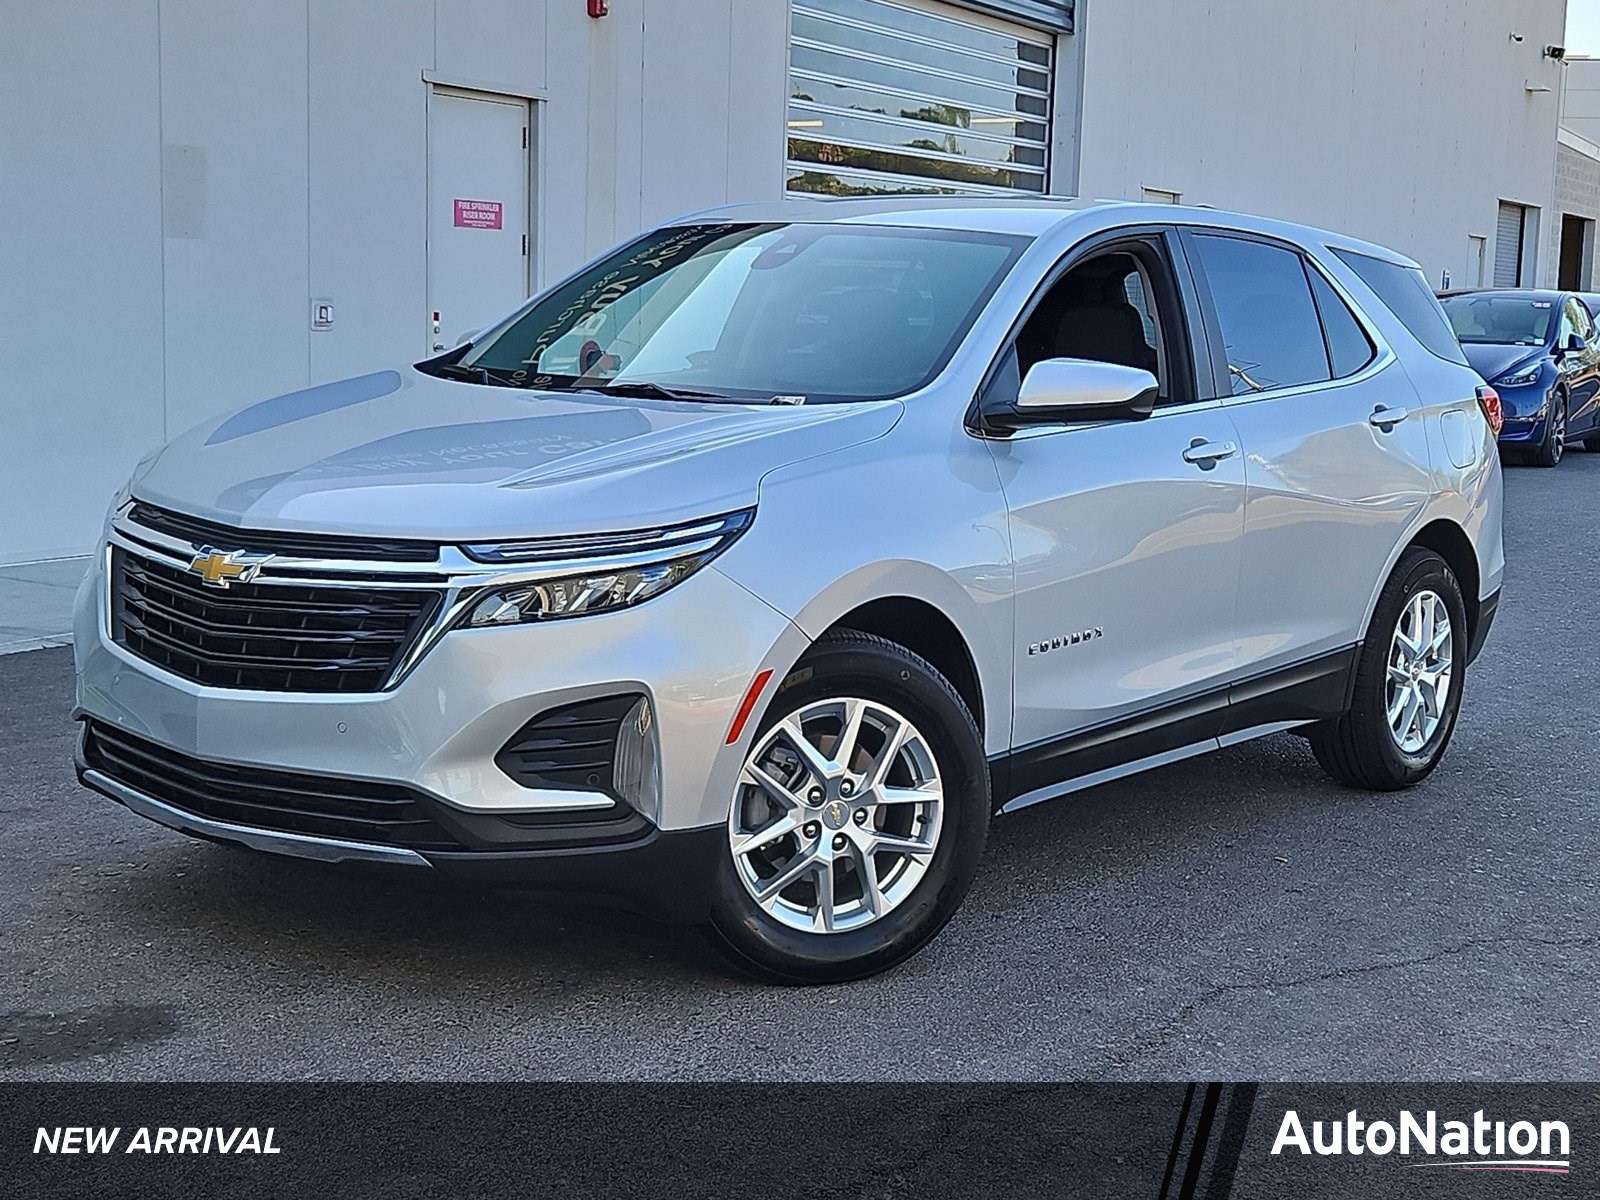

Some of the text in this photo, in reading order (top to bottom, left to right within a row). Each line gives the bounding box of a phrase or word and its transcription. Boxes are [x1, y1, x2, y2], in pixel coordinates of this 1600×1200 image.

[458, 201, 499, 212] FIRE SPRINKLER
[463, 210, 496, 220] RISER ROOM
[1027, 626, 1104, 656] EQUINOX
